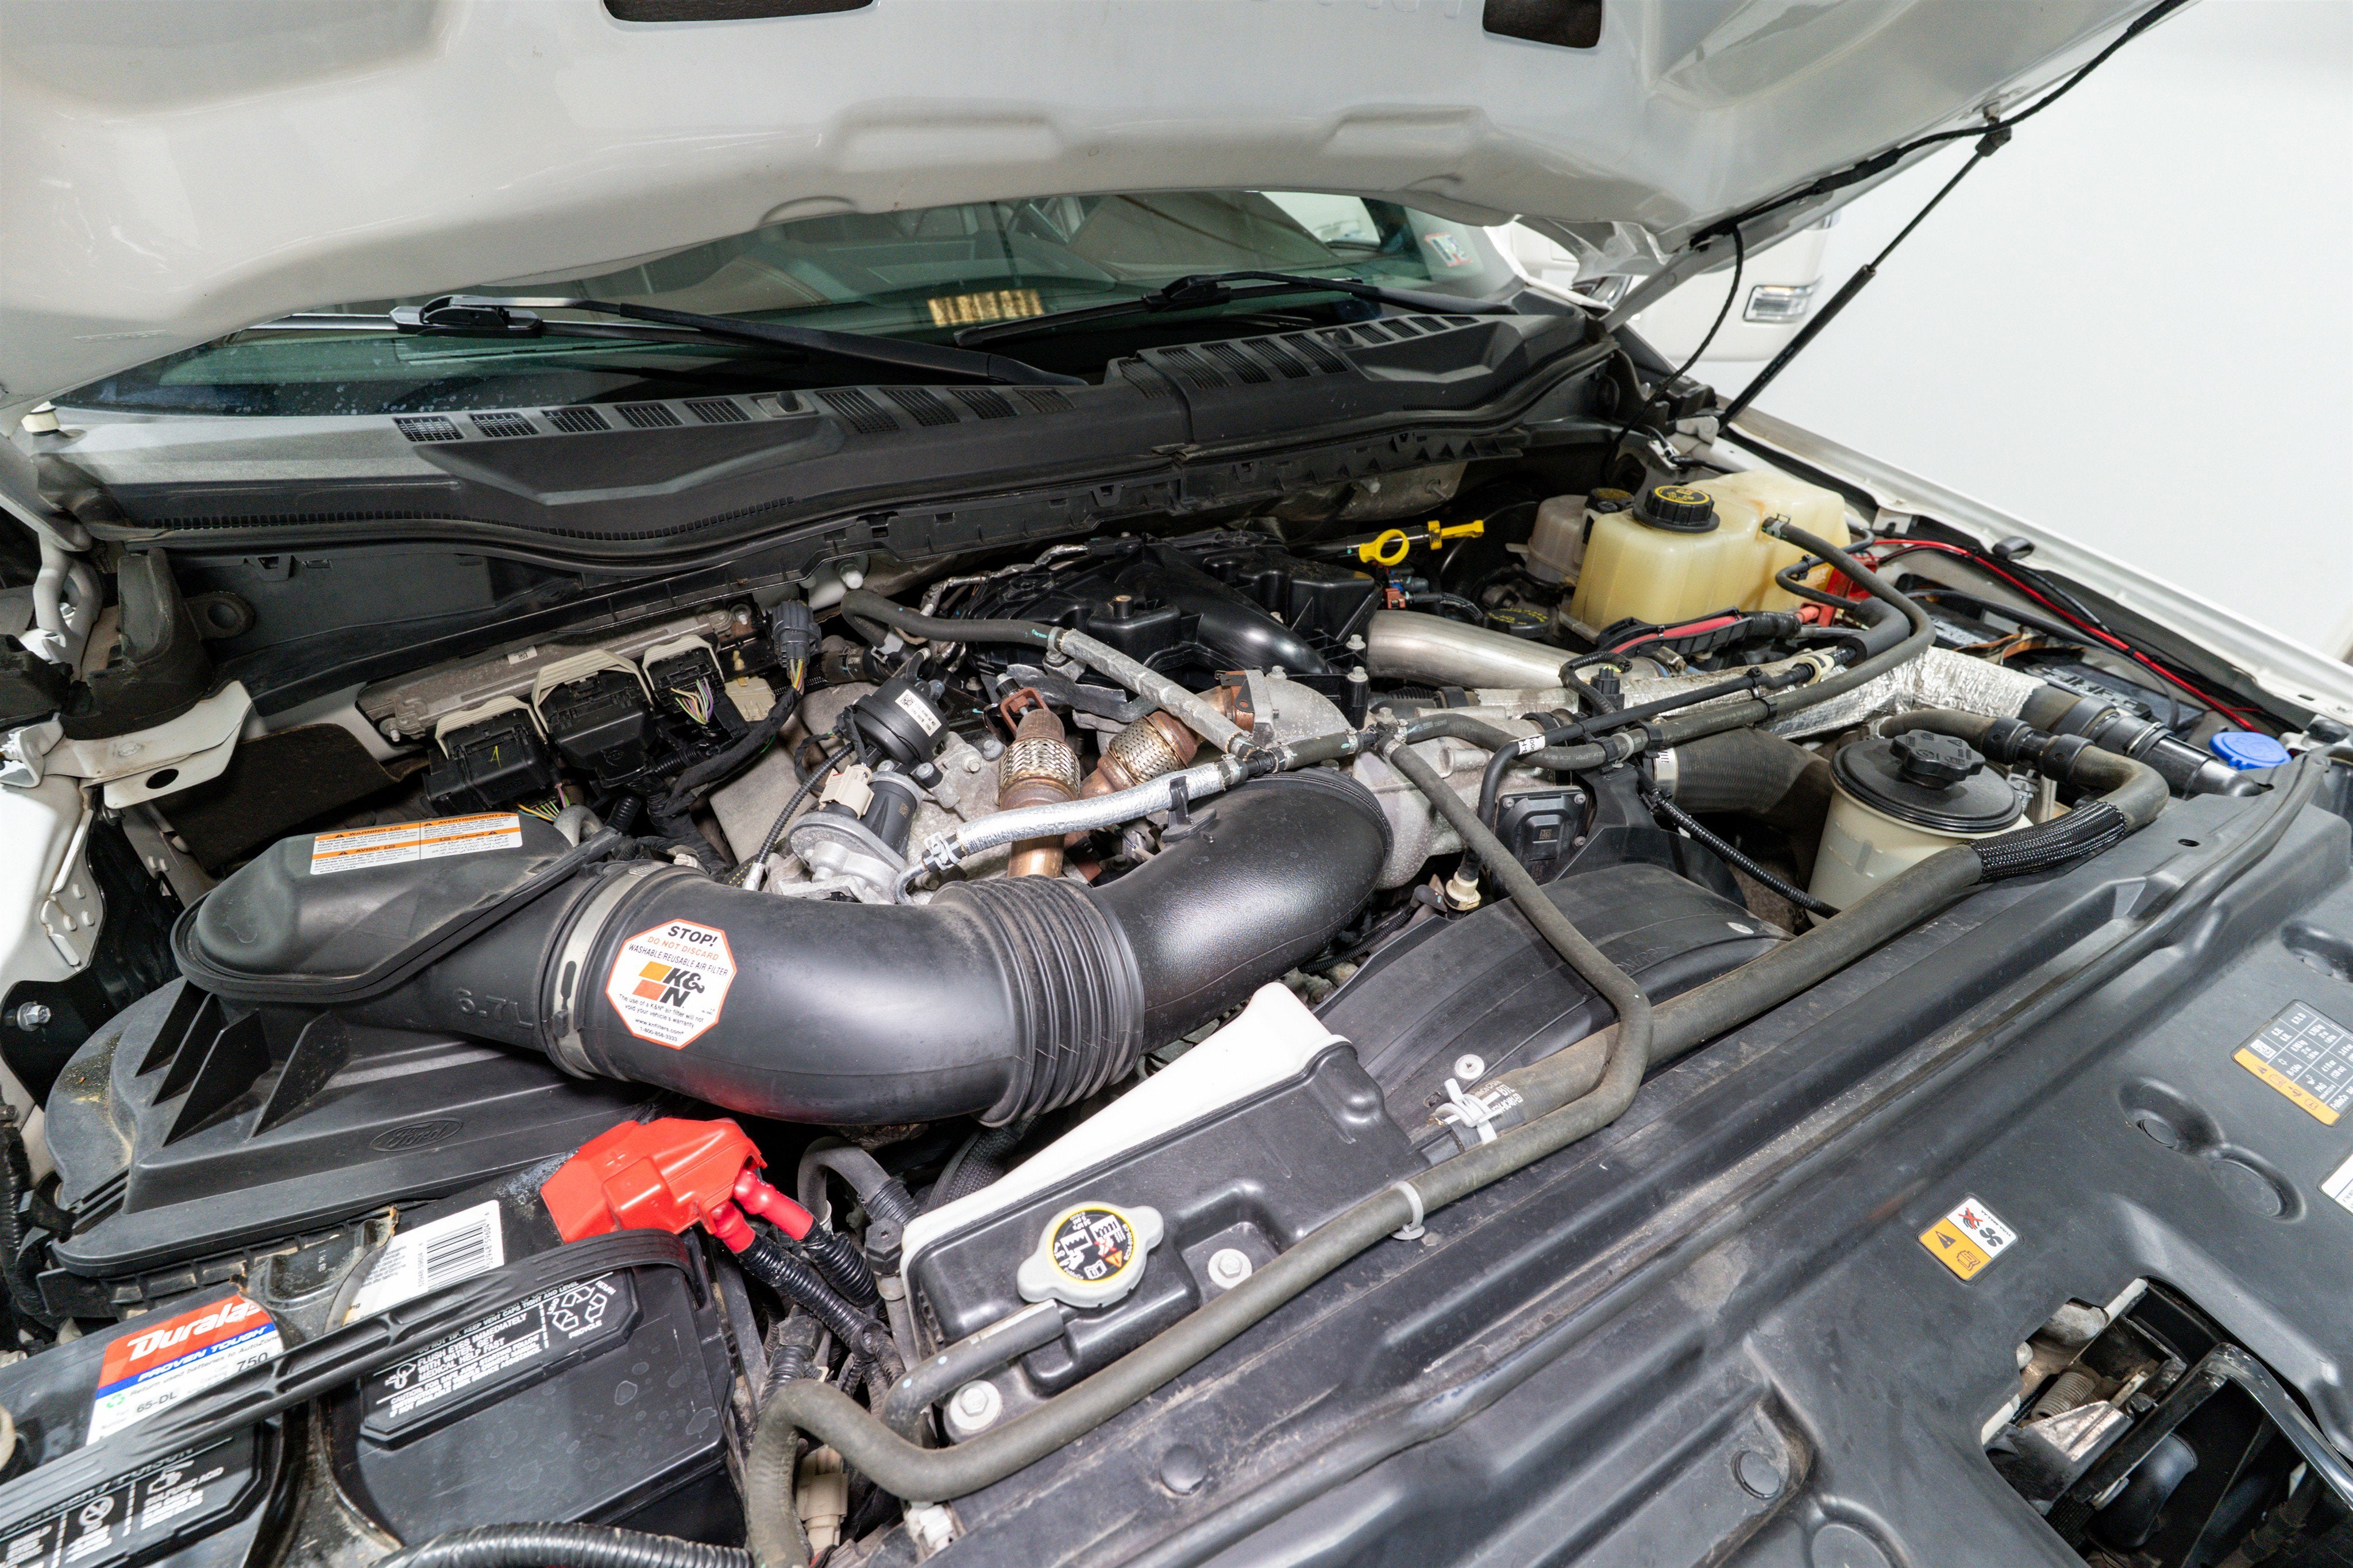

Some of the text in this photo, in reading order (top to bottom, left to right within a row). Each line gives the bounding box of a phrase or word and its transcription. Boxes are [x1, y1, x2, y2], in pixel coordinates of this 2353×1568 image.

[438, 814, 498, 824] AVERTISSEMENT
[668, 925, 718, 947] STOP!
[647, 936, 719, 961] DO NOT DISCARD
[708, 964, 728, 976] FILTER
[453, 987, 535, 1030] 6.7L
[673, 1009, 684, 1017] filter
[686, 1012, 694, 1020] will
[673, 1018, 695, 1029] warranty
[2286, 1064, 2303, 1076] R-134a
[2329, 1094, 2349, 1110] FoMoCo
[385, 1122, 450, 1150] Ford
[595, 1280, 616, 1296] RETURN
[464, 1322, 483, 1334] KEEP
[484, 1314, 501, 1326] VENT
[502, 1307, 521, 1318] CAPS
[522, 1296, 542, 1308] TIGHT
[543, 1289, 558, 1299] AND
[559, 1281, 579, 1292] LEVEL
[126, 1302, 262, 1362] Duralas
[416, 1313, 527, 1367] FLUSH EYES IMMEDIATELY
[568, 1320, 603, 1339] RECYCLE
[137, 1326, 268, 1382] PROVEN TOUGH
[236, 1352, 269, 1373] 750
[418, 1360, 441, 1374] WITH
[476, 1334, 495, 1347] GET
[418, 1338, 506, 1382] MEDICAL HELP FAST
[425, 1381, 439, 1391] FOR
[440, 1372, 458, 1384] SAFE
[459, 1362, 479, 1376] JUMP
[479, 1347, 511, 1366] STARTING
[512, 1334, 539, 1349] FOLLOW
[130, 1381, 160, 1396] Return
[163, 1372, 184, 1384] used
[187, 1357, 225, 1374] batteries
[136, 1392, 178, 1413] 65-DL
[198, 1466, 225, 1485] ACID
